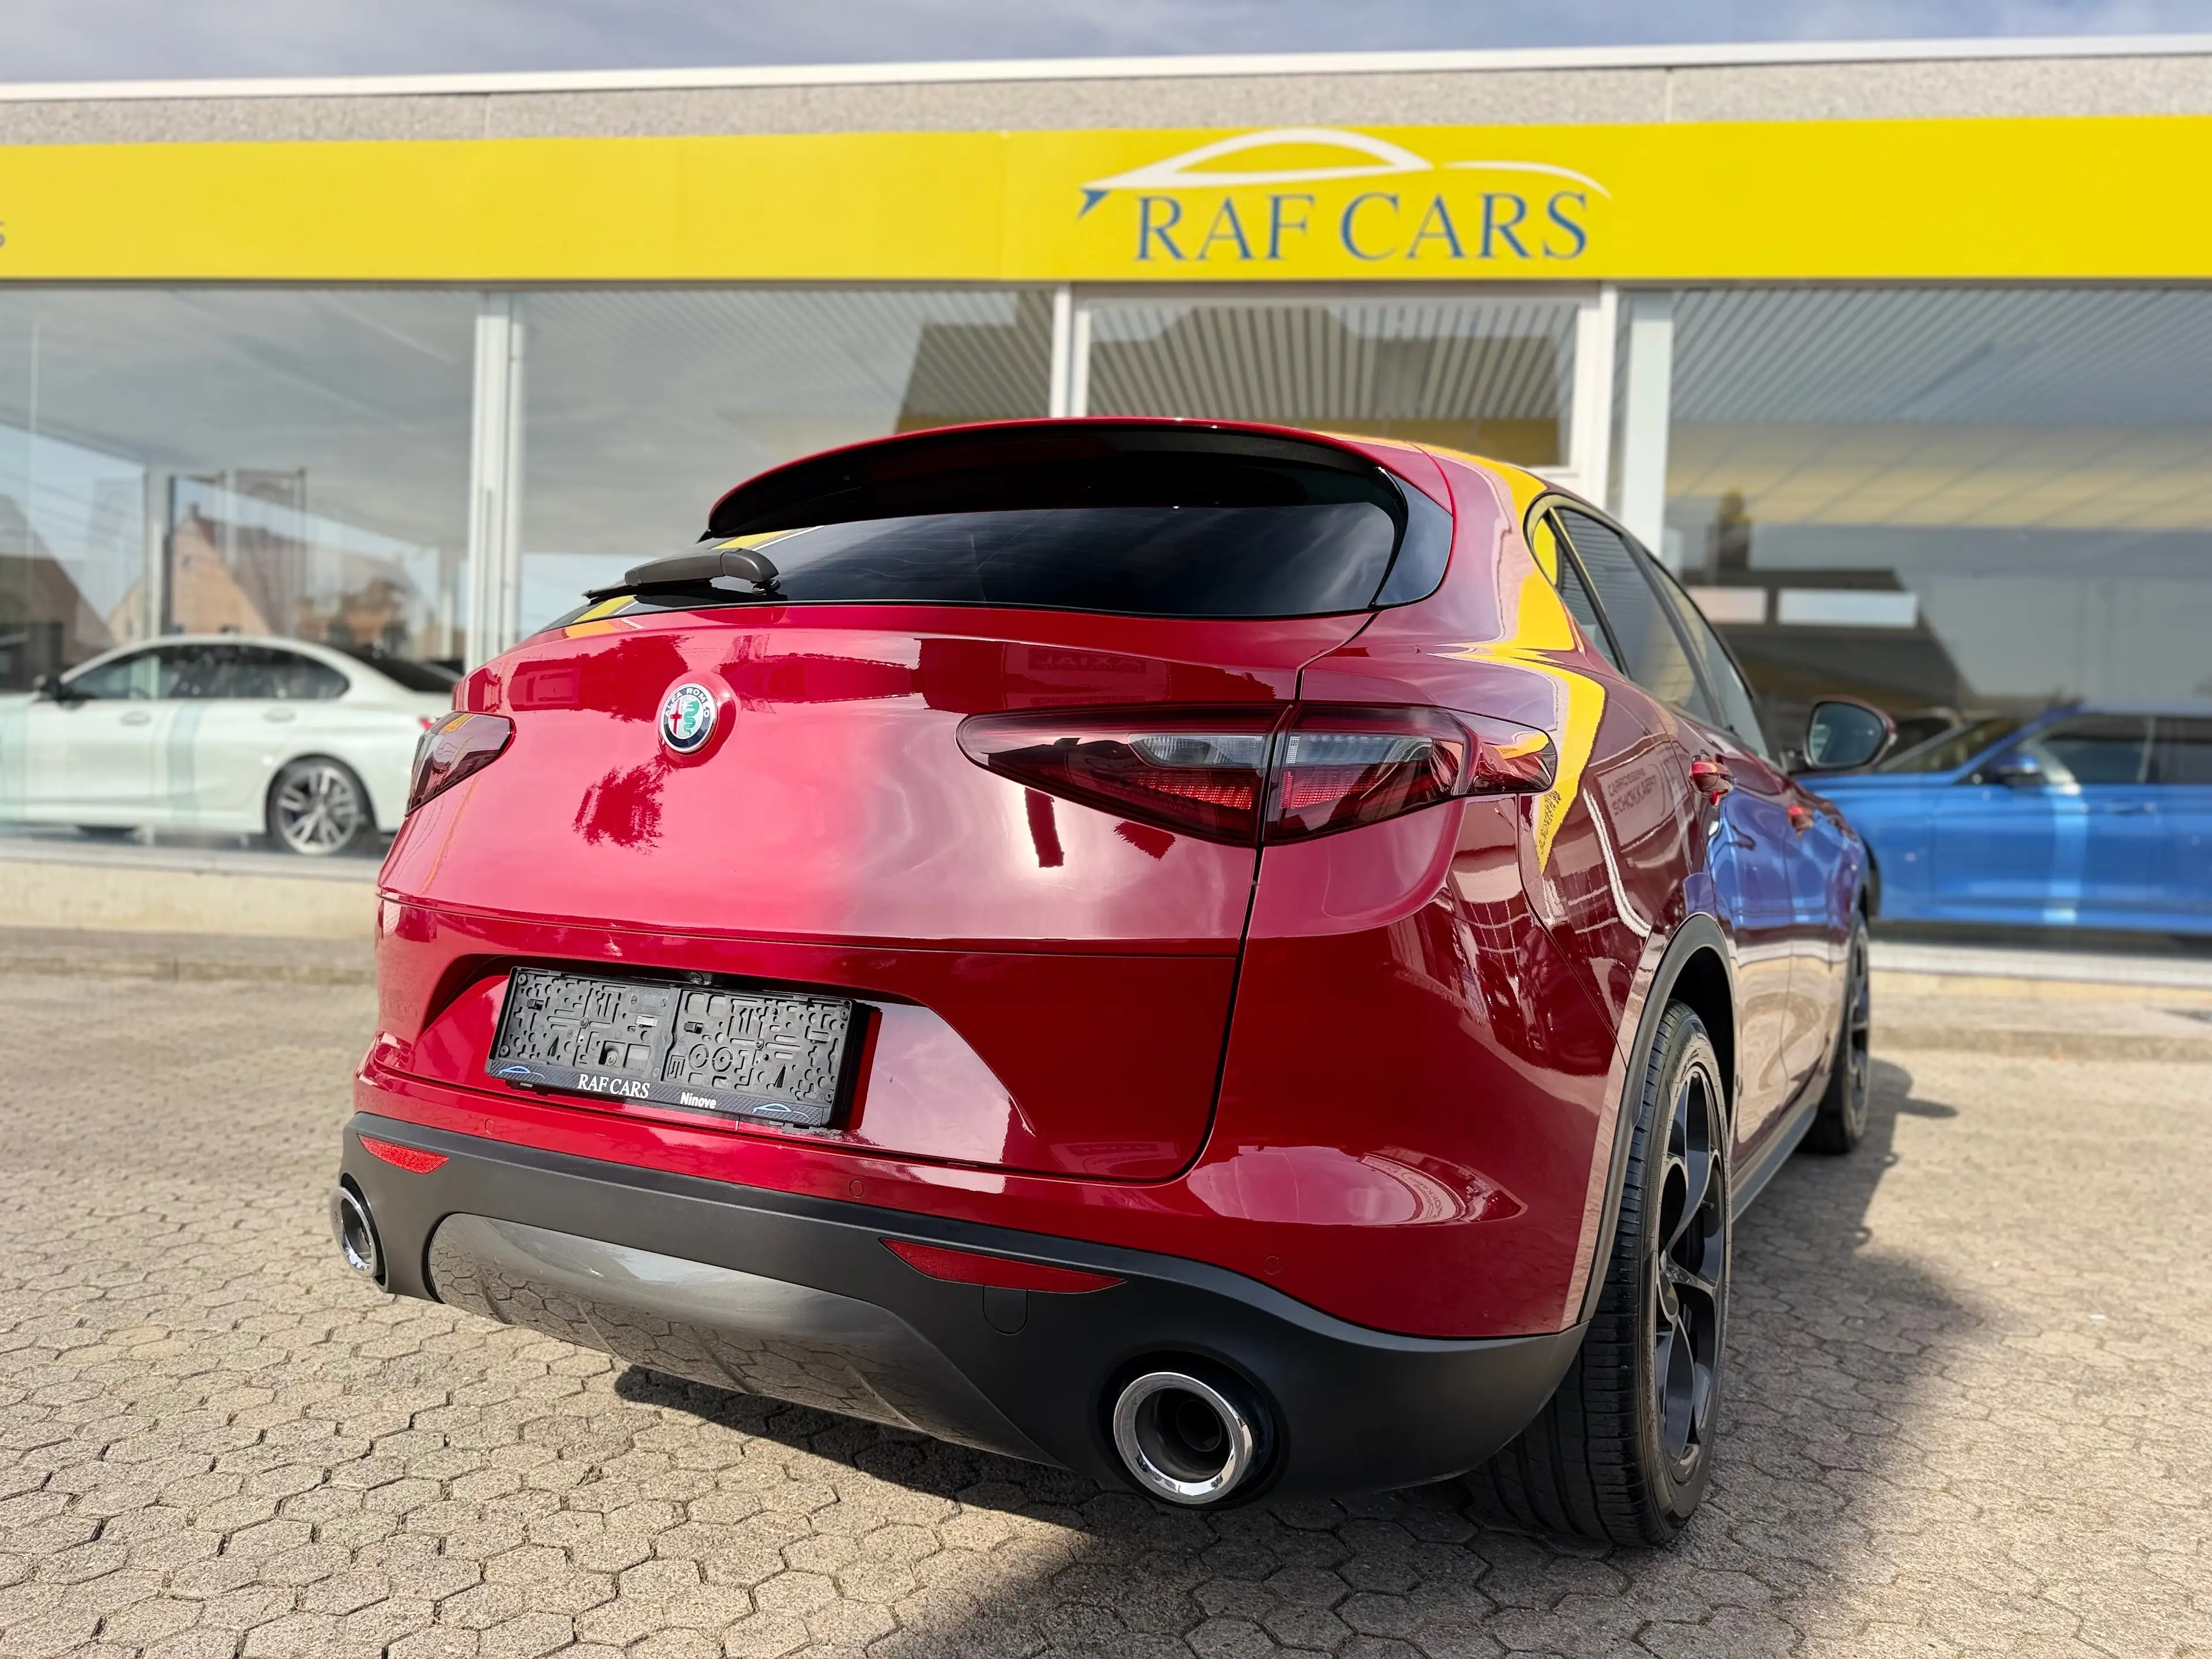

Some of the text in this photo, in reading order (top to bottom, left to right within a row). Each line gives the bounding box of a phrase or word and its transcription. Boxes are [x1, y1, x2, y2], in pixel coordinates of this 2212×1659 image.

[1133, 191, 1589, 262] RAF CARS
[665, 687, 710, 718] ALFA ROMO
[577, 1073, 650, 1099] RAF CARS
[680, 1091, 717, 1110] Ninove
